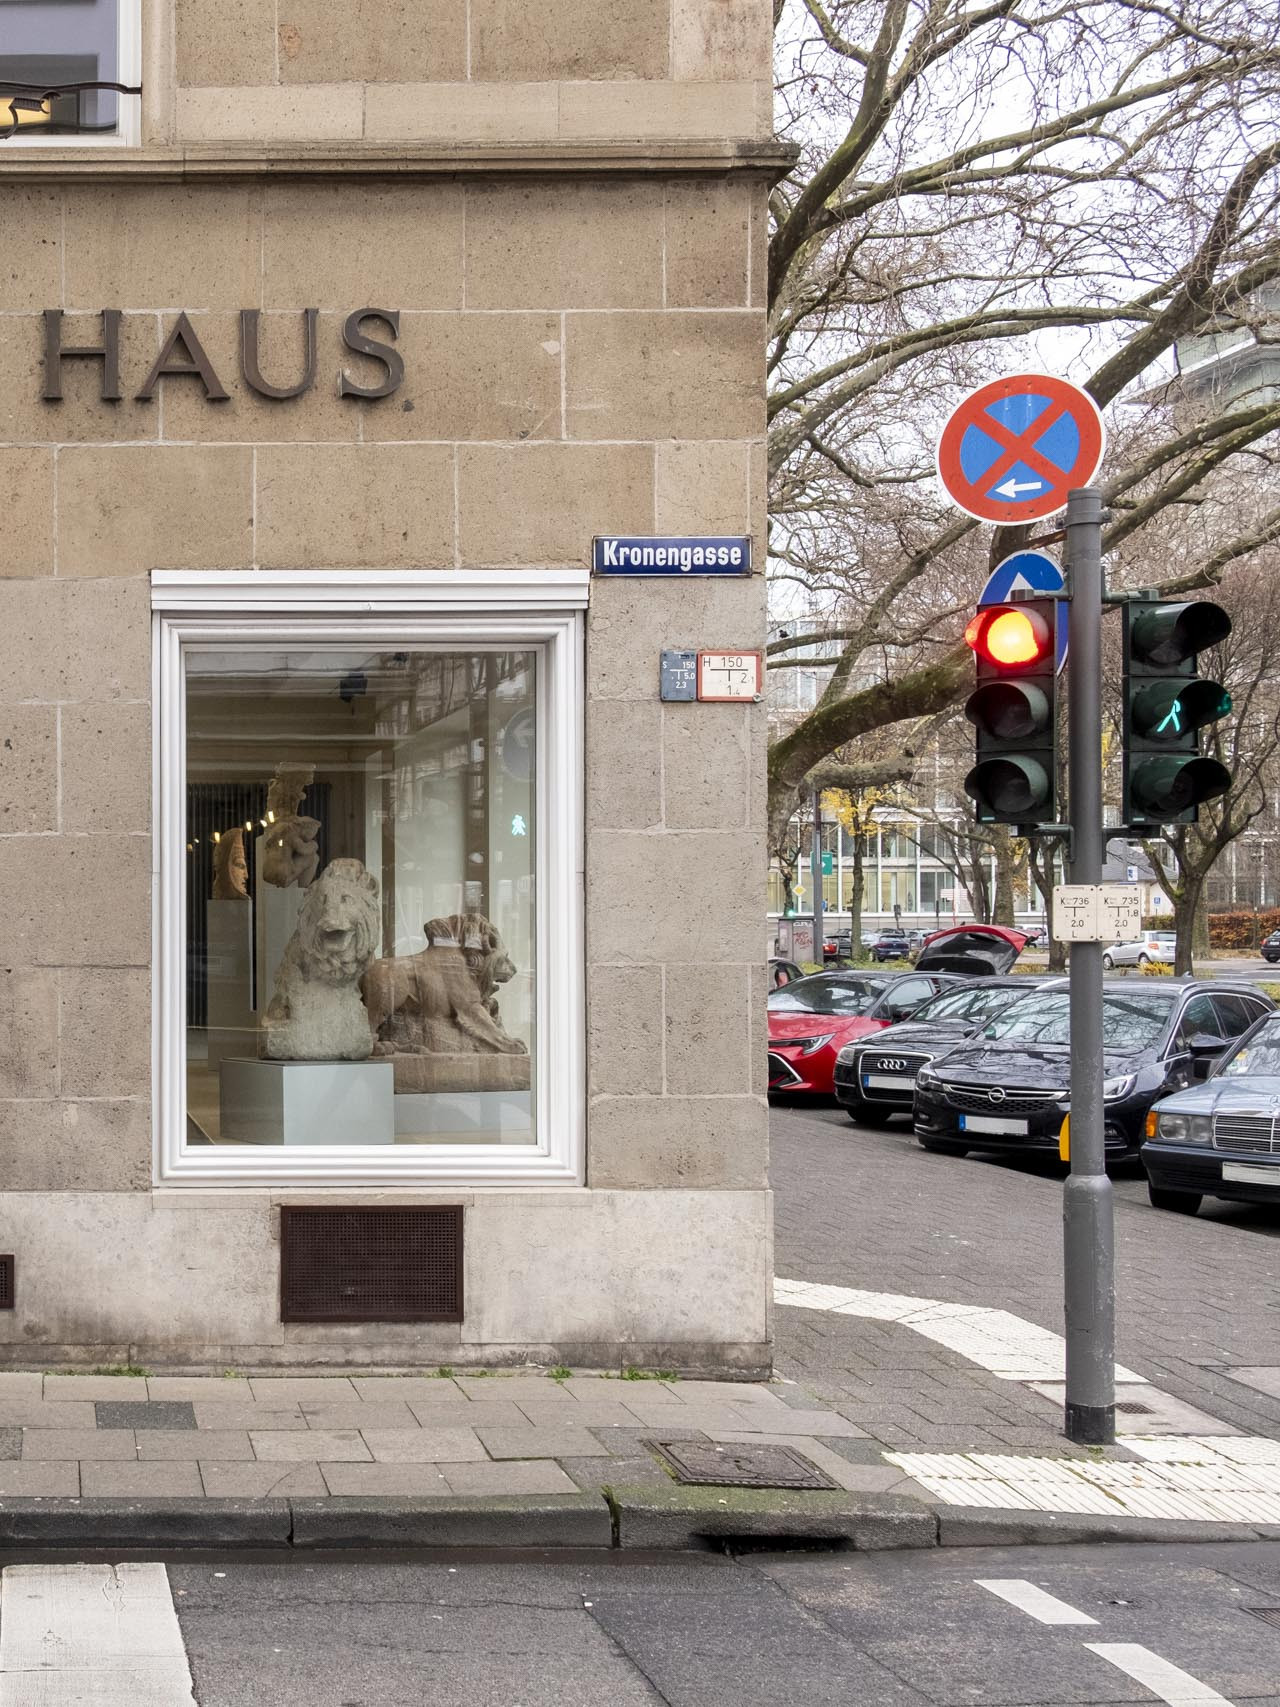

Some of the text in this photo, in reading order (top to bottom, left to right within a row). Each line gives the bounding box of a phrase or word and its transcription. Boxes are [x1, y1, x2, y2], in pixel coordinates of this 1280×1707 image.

[41, 308, 406, 401] HAUS
[603, 540, 742, 572] Kronengasse
[662, 661, 696, 669] S 150
[703, 656, 743, 668] H 150
[683, 672, 696, 680] 5.0
[675, 681, 687, 689] 2.3
[1060, 897, 1066, 905] K
[1072, 897, 1090, 905] 736
[1103, 897, 1110, 905] K
[1121, 896, 1139, 905] 735
[1126, 909, 1139, 917] 1.8
[1071, 919, 1085, 928] 2.0
[1114, 919, 1128, 928] 2.0
[1071, 930, 1078, 939] L
[1115, 930, 1121, 938] A
